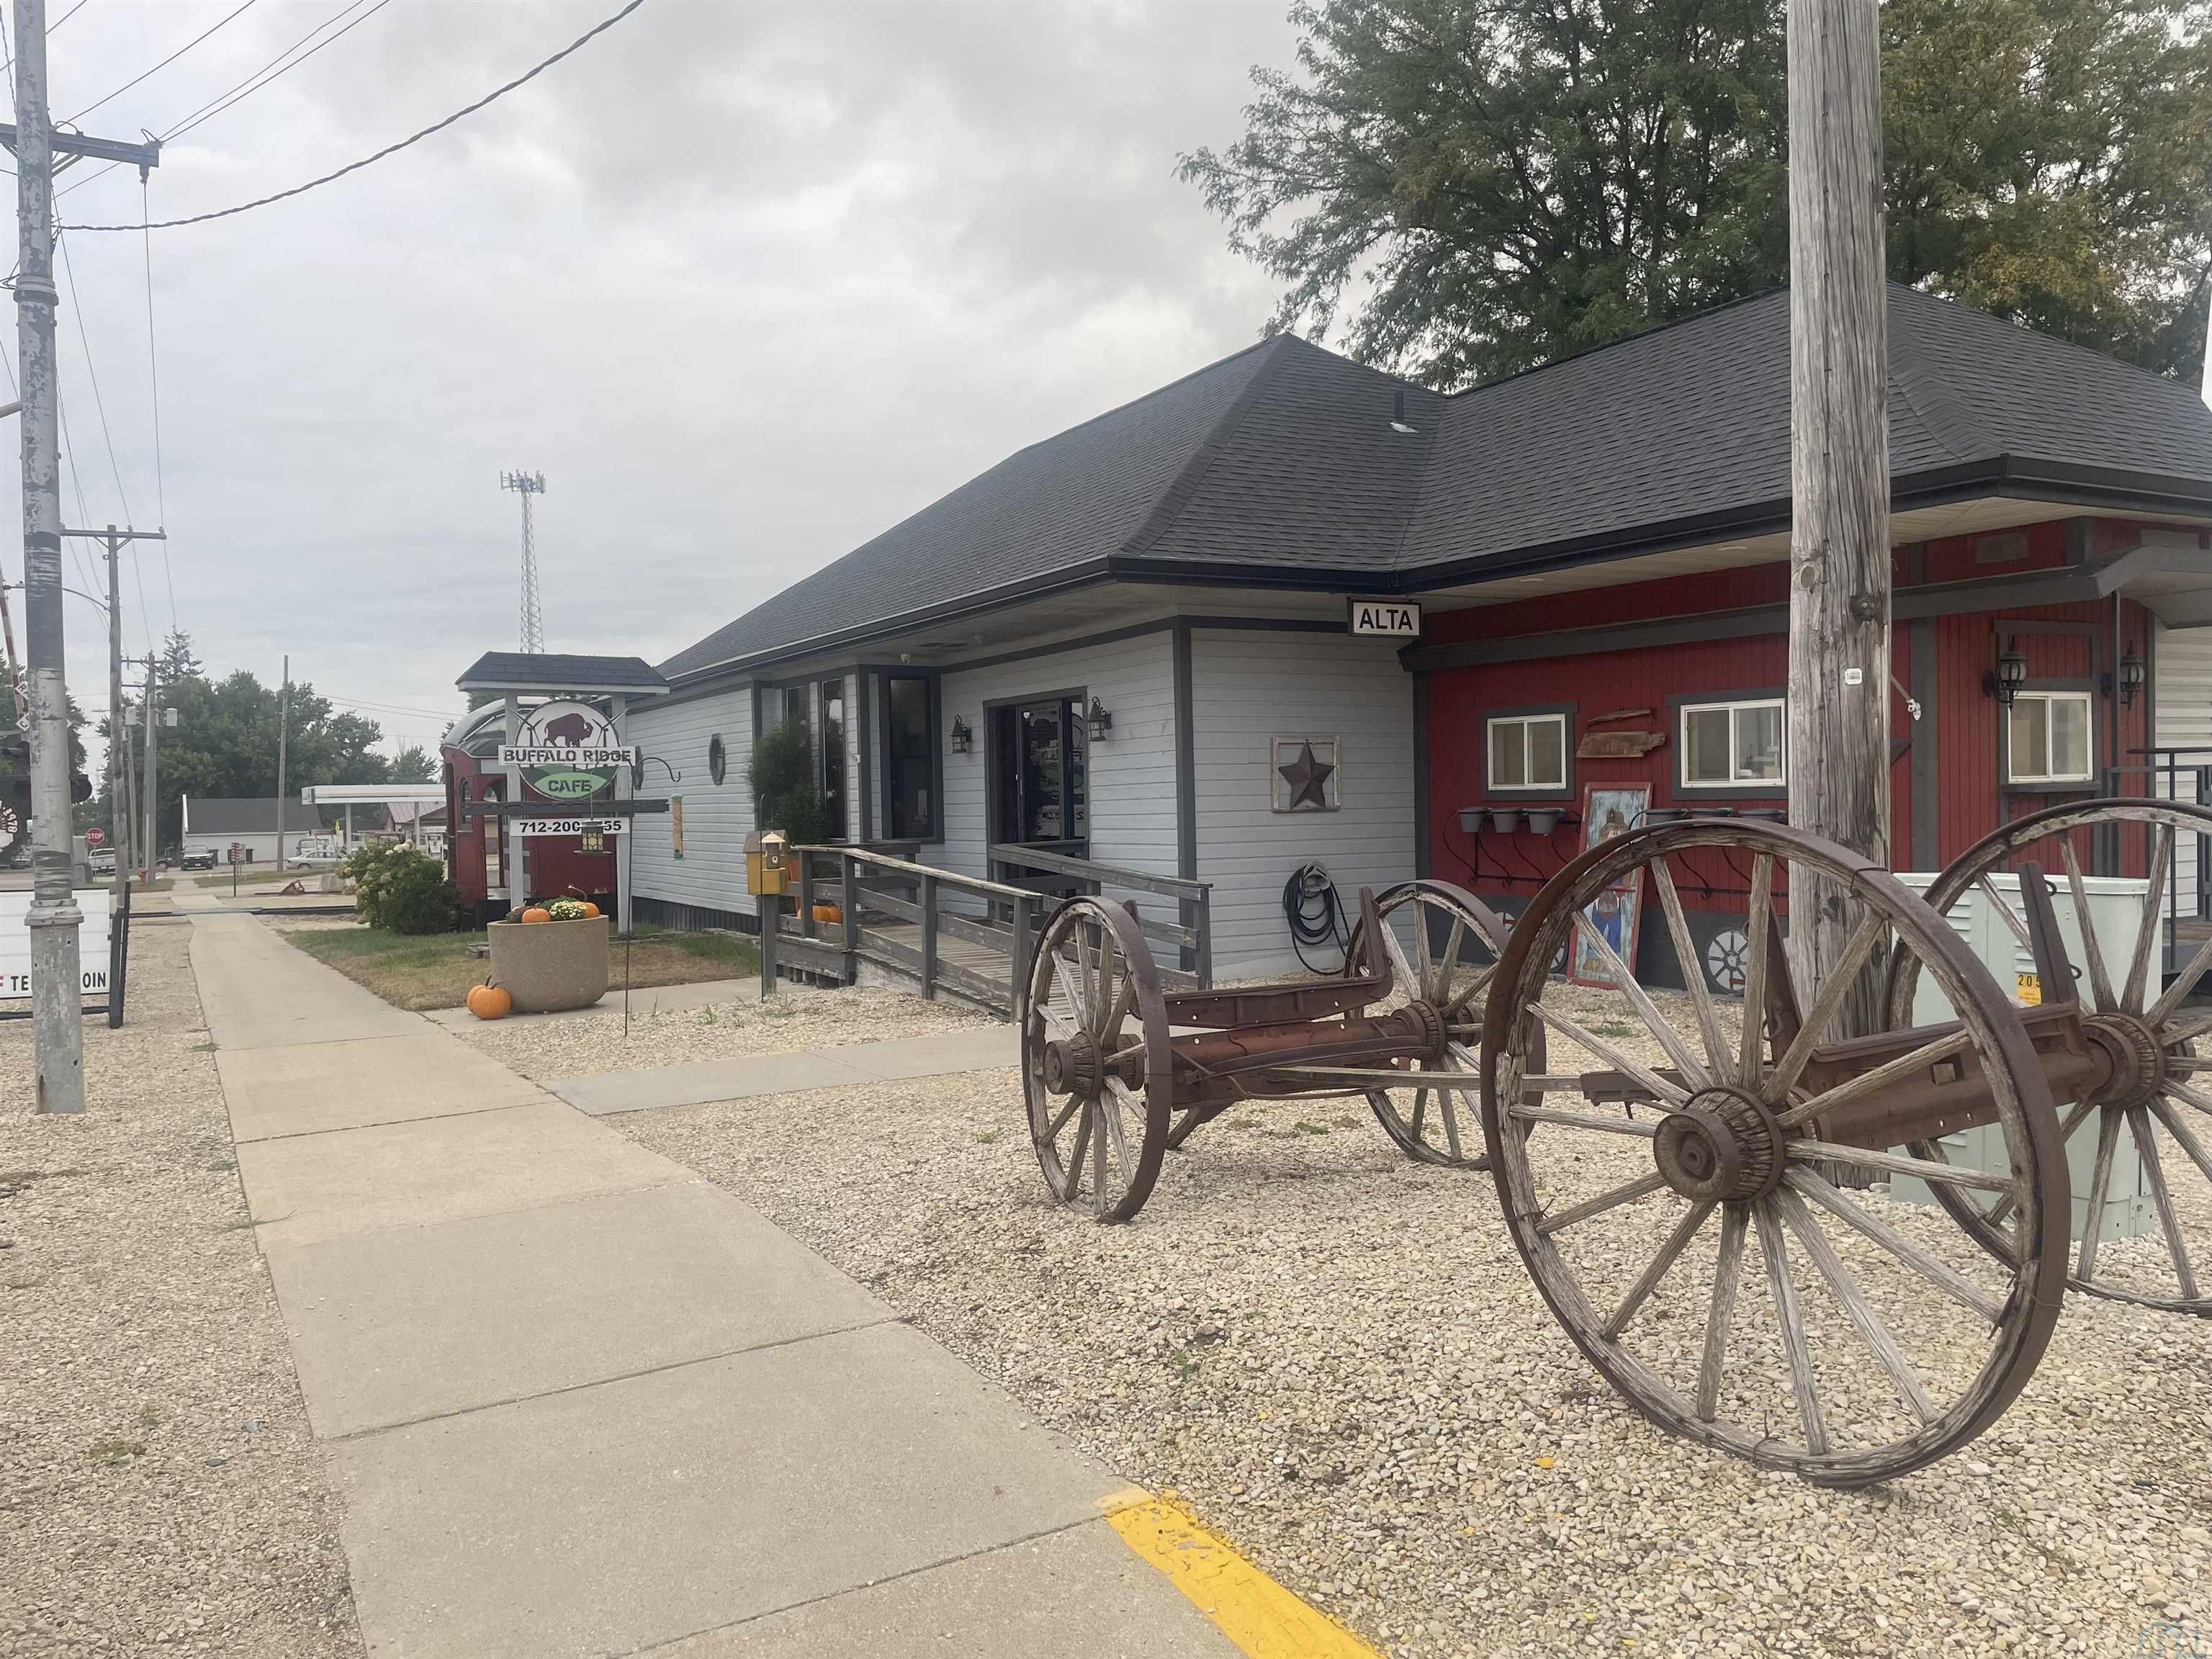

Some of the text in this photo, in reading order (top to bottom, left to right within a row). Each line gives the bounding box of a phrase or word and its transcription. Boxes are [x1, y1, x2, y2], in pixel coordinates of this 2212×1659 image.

[1359, 608, 1413, 630] ALTA
[503, 750, 631, 763] BUFFALO RIDGE
[548, 779, 592, 793] CAFE
